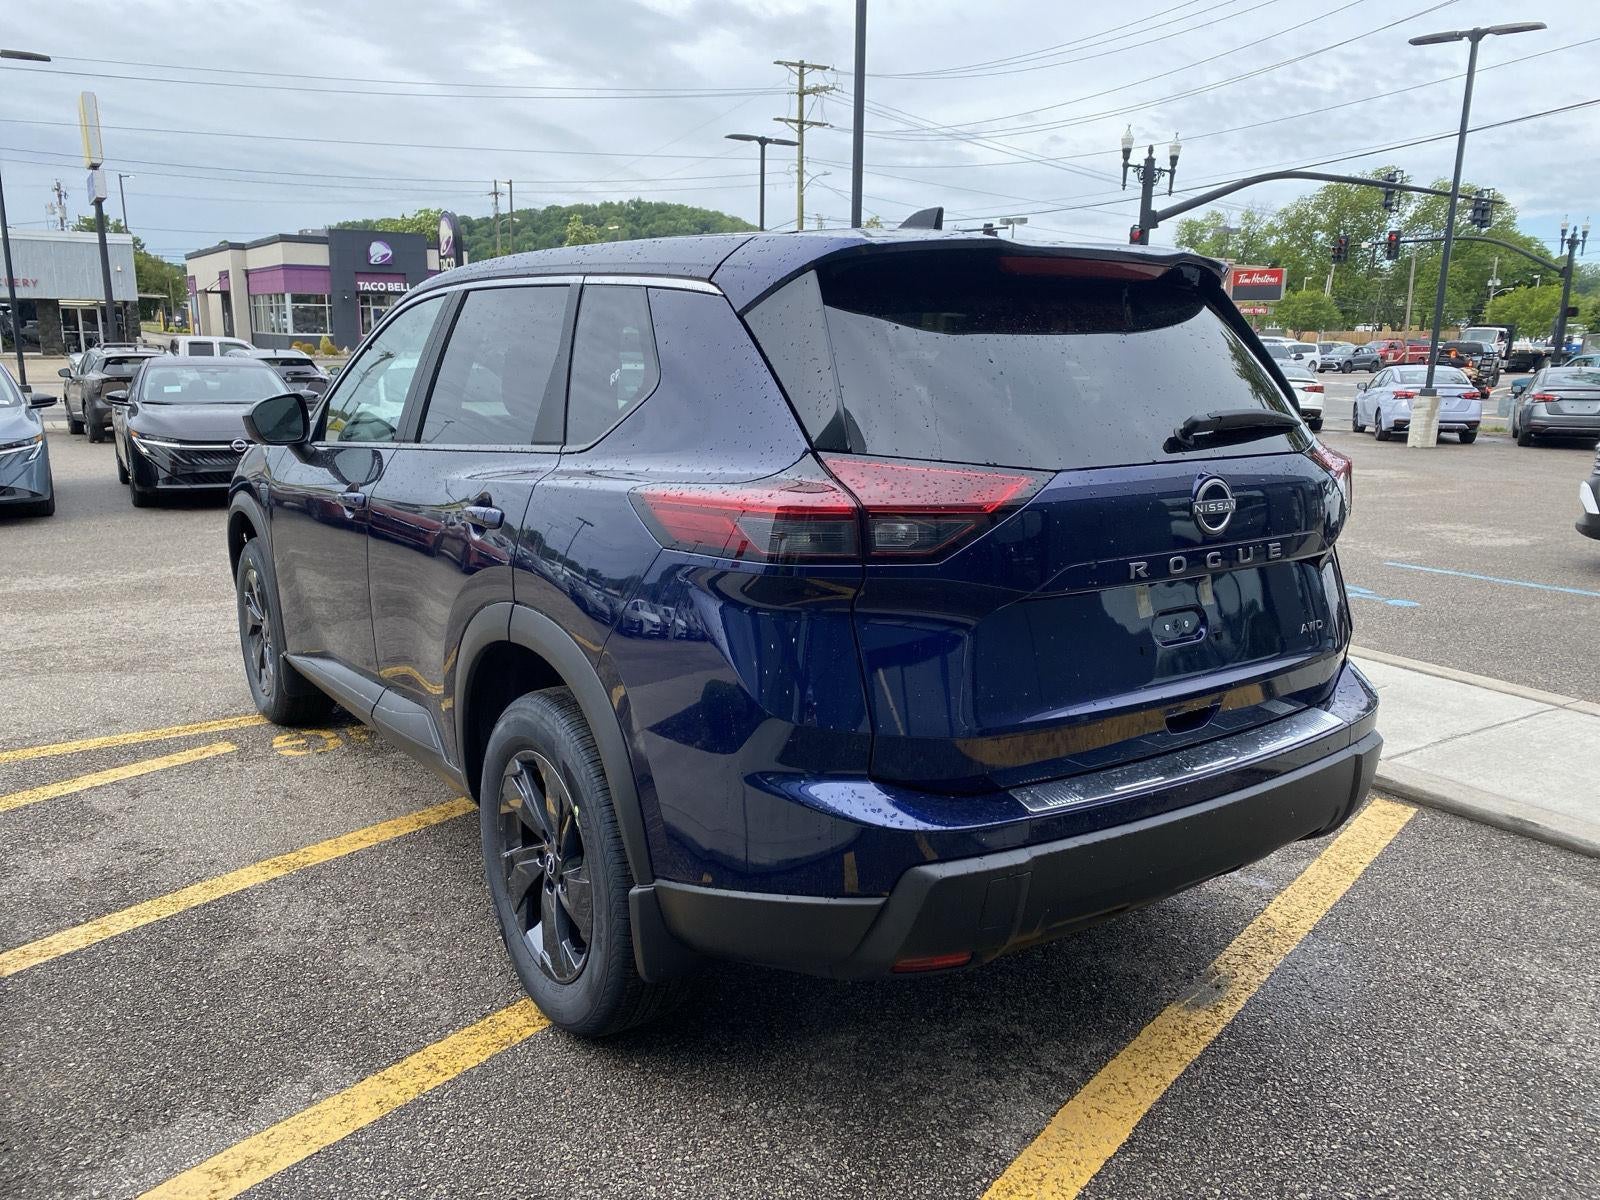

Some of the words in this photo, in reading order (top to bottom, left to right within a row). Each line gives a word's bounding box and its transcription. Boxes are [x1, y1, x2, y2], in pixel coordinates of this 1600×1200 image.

[440, 257, 456, 272] TACO
[1238, 273, 1252, 284] Tim
[1250, 272, 1278, 284] Hortons
[357, 281, 386, 291] TACO
[387, 282, 411, 292] BELL
[1194, 501, 1236, 513] NISSAN
[1128, 542, 1282, 580] ROGUE
[1300, 619, 1323, 634] AWD
